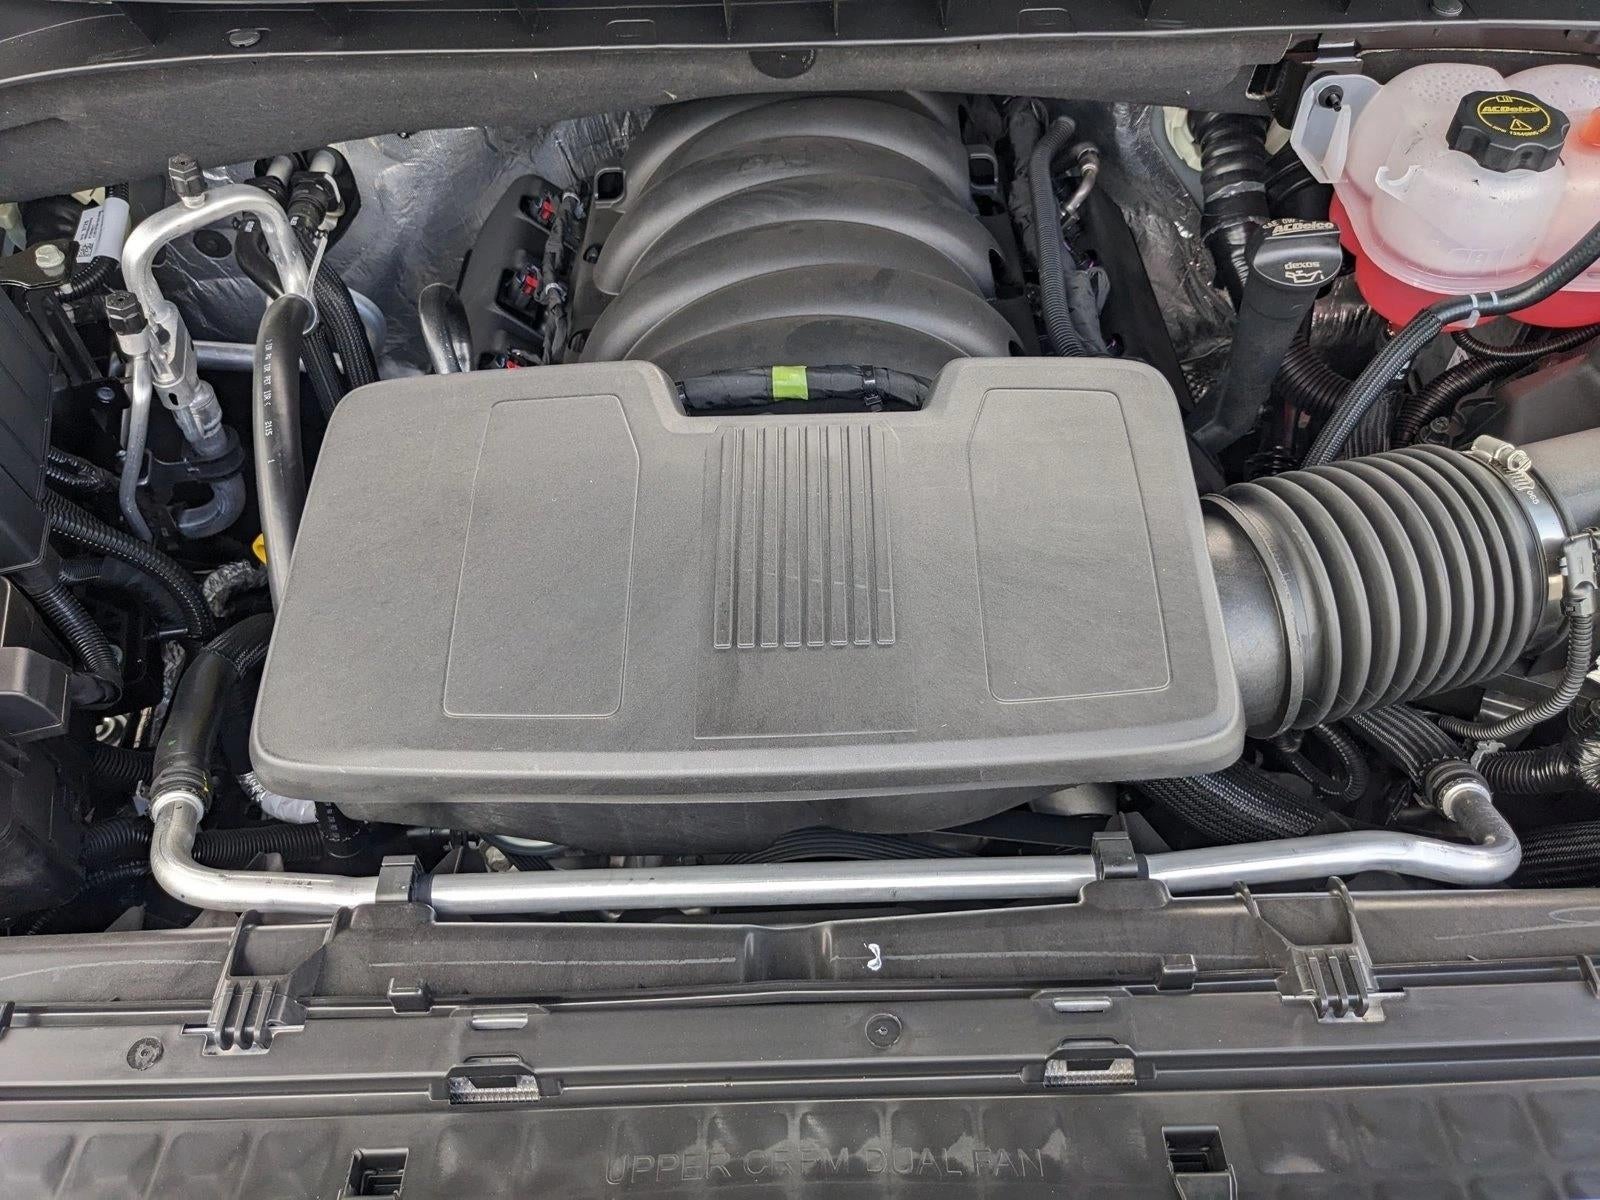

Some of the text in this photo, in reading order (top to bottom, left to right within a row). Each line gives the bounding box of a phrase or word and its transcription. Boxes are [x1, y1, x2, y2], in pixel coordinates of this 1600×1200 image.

[1481, 106, 1541, 114] ACDelco
[1272, 221, 1334, 236] ACDelco
[1284, 261, 1320, 269] dexos
[604, 1149, 732, 1184] UPPER
[865, 1146, 963, 1178] DUAL
[972, 1147, 1046, 1179] FAN
